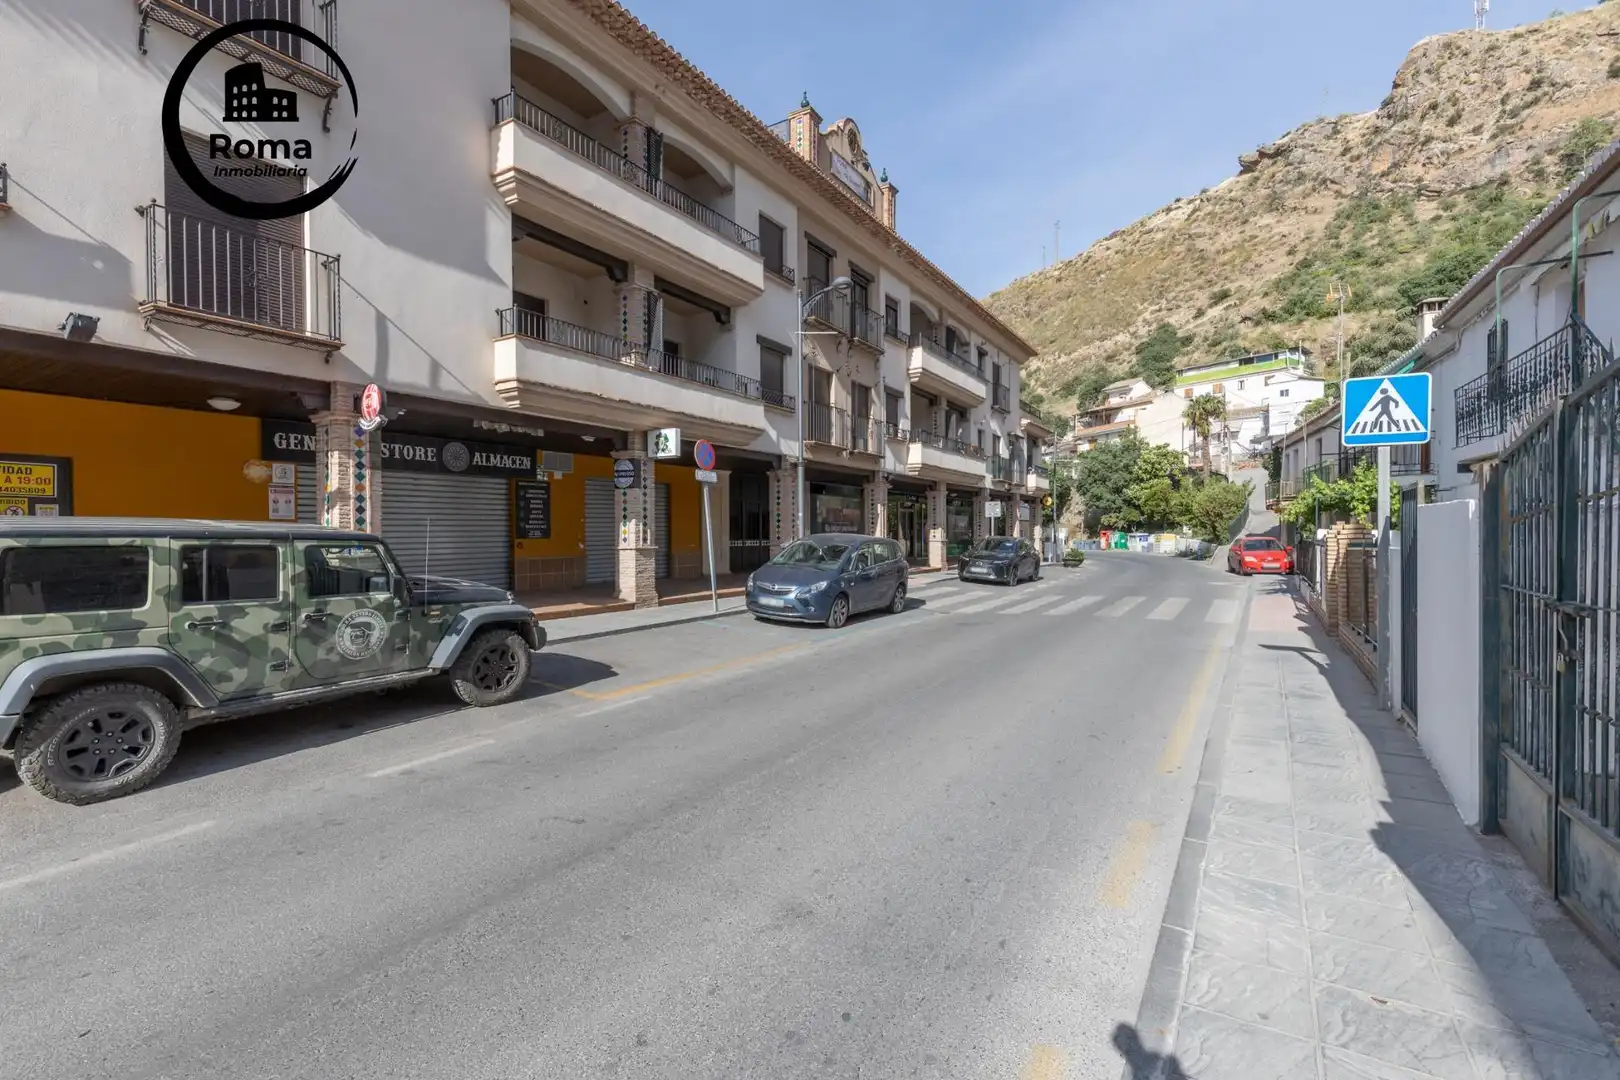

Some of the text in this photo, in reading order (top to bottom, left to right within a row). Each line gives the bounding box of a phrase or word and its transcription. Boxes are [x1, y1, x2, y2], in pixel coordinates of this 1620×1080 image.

[381, 443, 437, 462] STORE
[472, 451, 532, 470] ALMACEN
[4, 475, 12, 484] A
